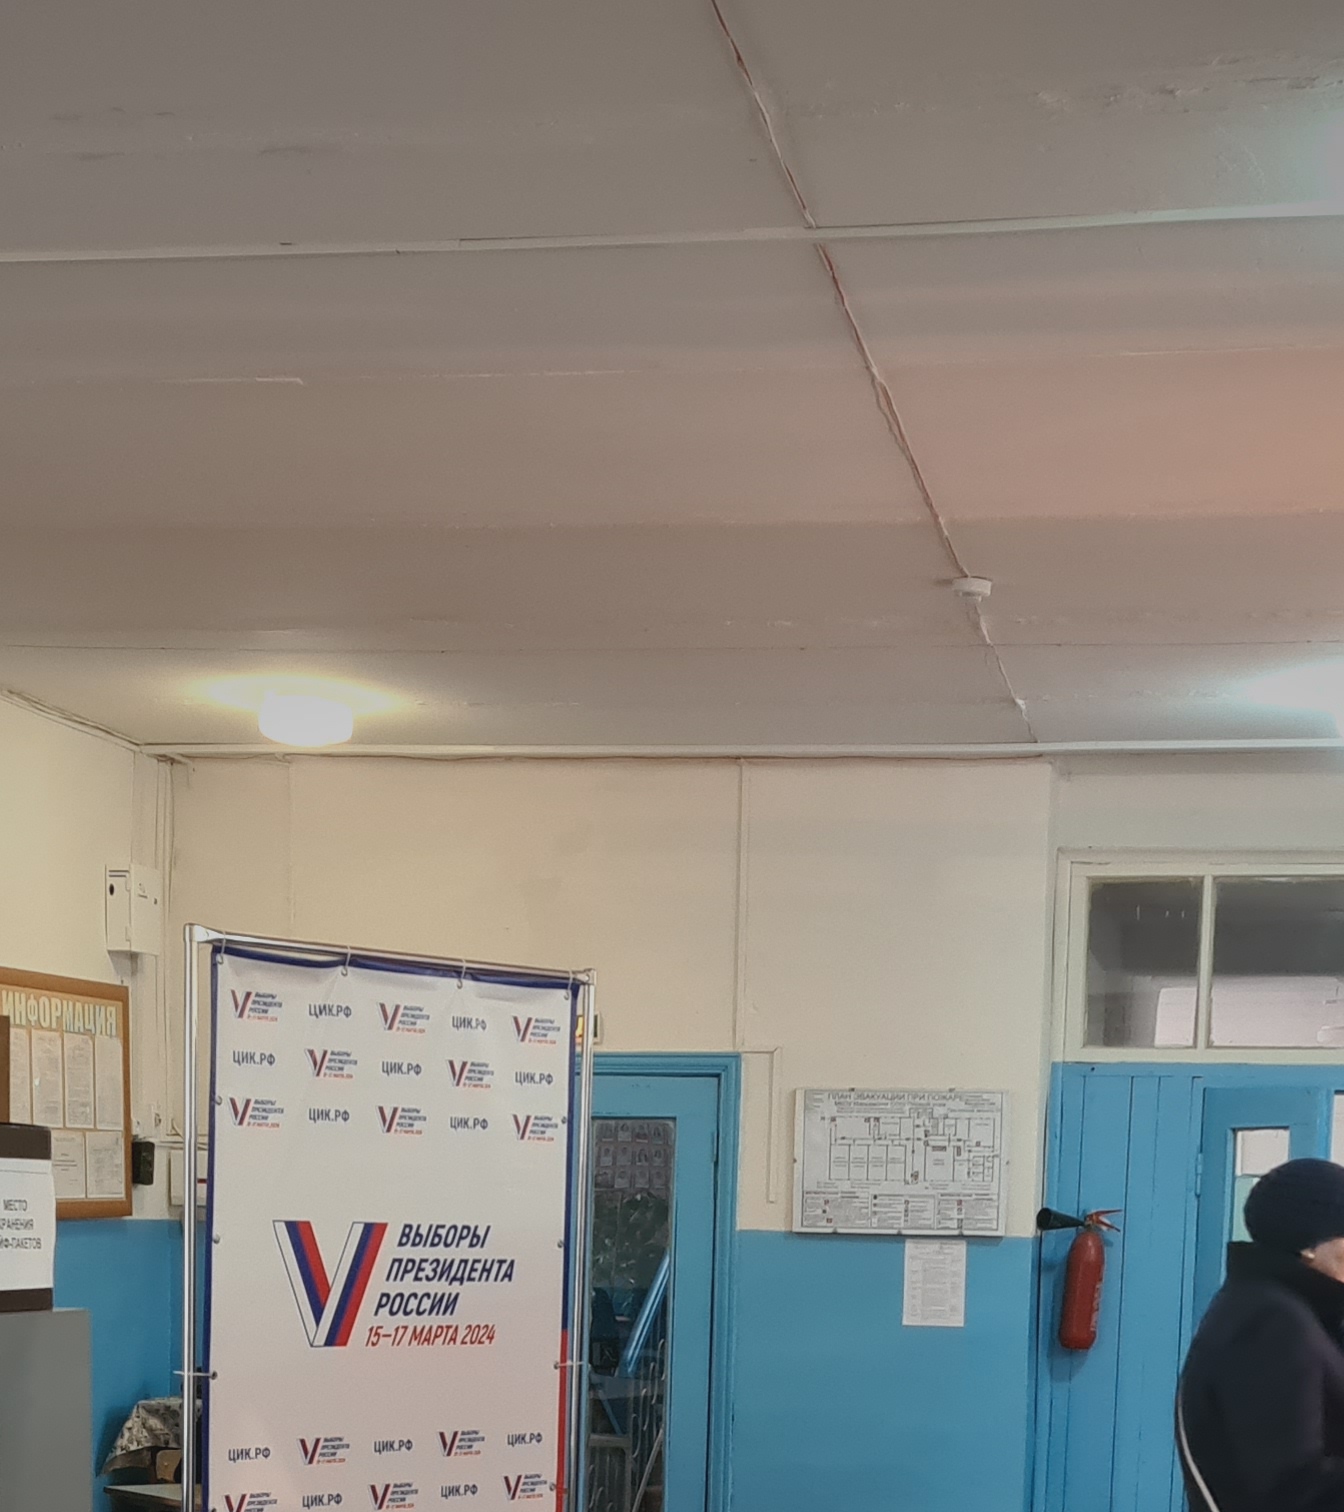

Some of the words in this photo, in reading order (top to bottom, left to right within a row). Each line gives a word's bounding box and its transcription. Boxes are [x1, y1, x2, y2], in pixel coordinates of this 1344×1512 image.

[1, 989, 117, 1037] ИНФОРМАЦИЯ
[2, 1199, 28, 1212] МЕСТО
[397, 1223, 491, 1249] ВЫБОРЫ
[385, 1257, 515, 1286] ПРЕЗИДЕНТА
[373, 1291, 459, 1317] РОССИИ
[409, 1325, 457, 1346] МАРТА
[460, 1323, 496, 1345] 2024
